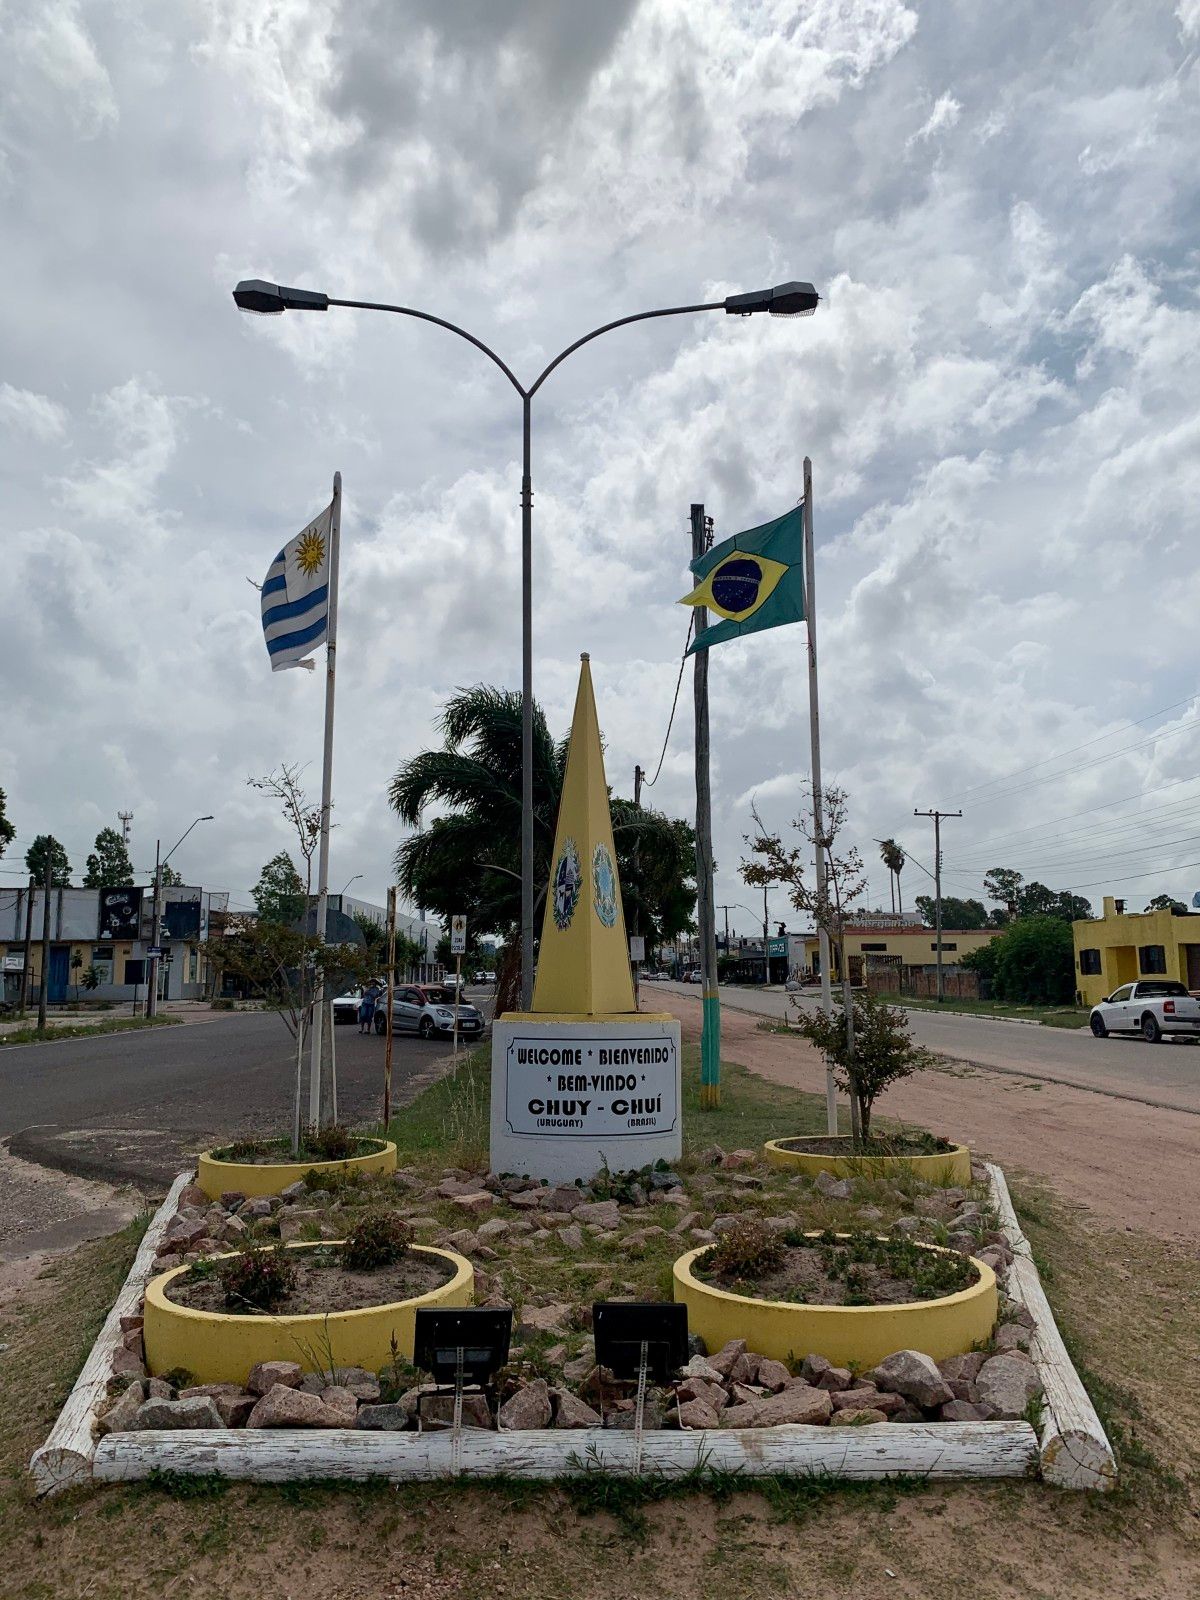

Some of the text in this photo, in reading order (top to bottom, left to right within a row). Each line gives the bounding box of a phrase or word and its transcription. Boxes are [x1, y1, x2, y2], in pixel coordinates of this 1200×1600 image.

[517, 1047, 669, 1066] WELCOME BIENVENIDO
[558, 1074, 637, 1091] BEM-VINDO
[528, 1099, 592, 1115] CHUY
[611, 1093, 662, 1116] CHUÍ
[536, 1117, 657, 1128] (URUGUAY) (BRASIL)
